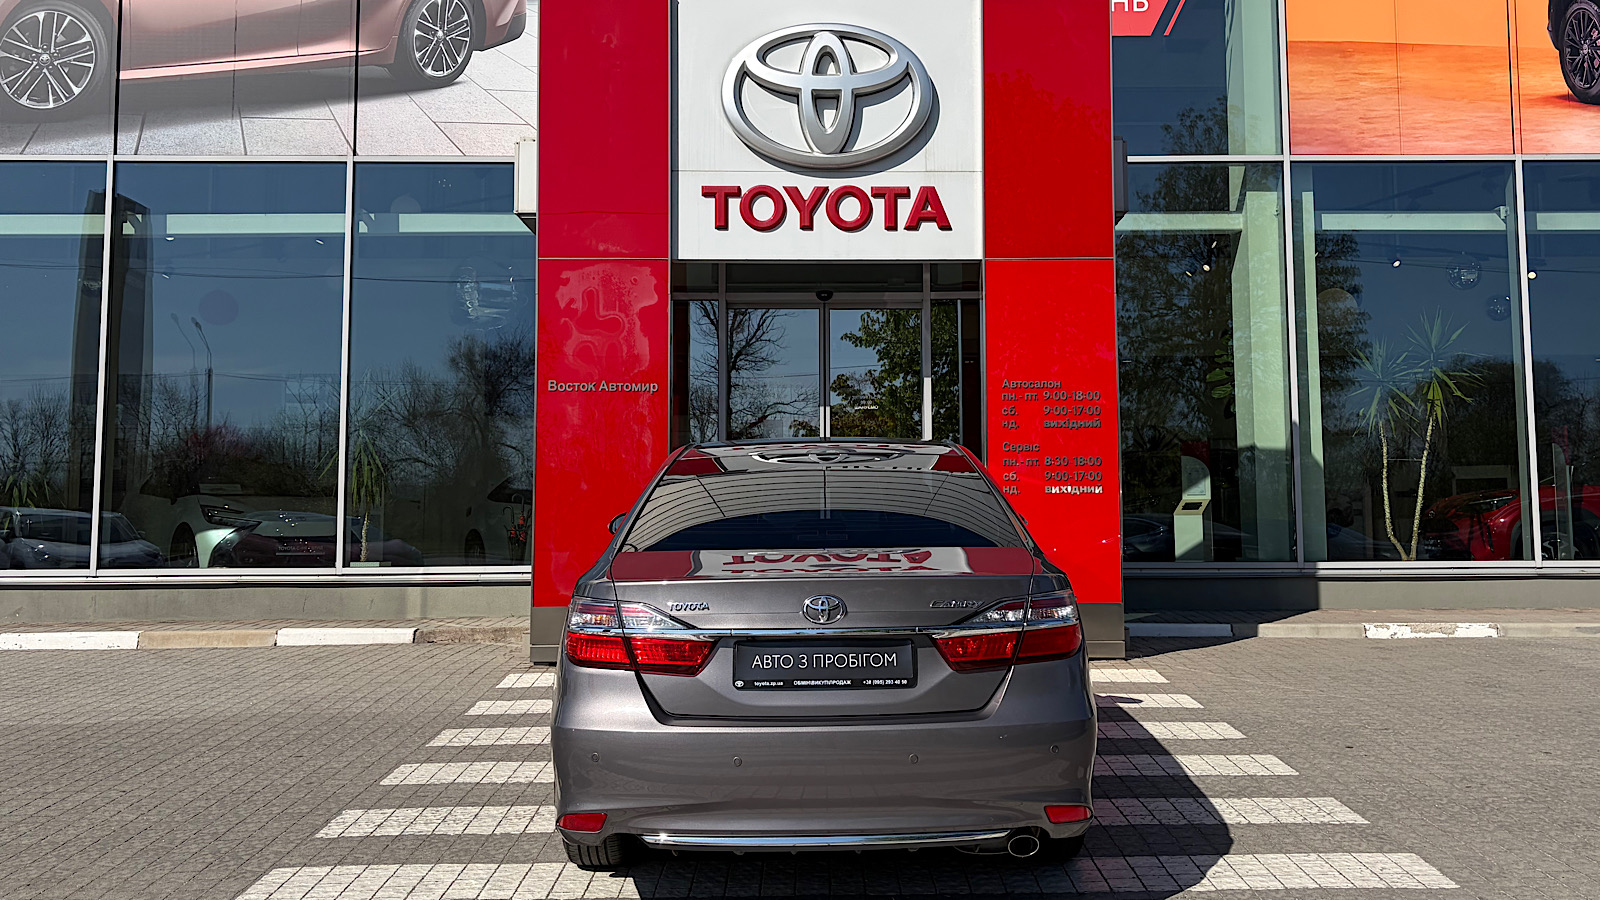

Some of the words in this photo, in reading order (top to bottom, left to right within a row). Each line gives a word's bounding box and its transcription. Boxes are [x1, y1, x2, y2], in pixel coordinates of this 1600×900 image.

[701, 185, 953, 233] TOYOTA
[548, 380, 597, 392] Восток
[599, 380, 659, 395] Автомир
[1002, 379, 1062, 389] Автосалон
[1043, 391, 1101, 401] 9:00-18:00
[1002, 406, 1019, 416] сб.
[1043, 406, 1102, 416] 9:00-17:00
[1002, 420, 1020, 430] нд.
[1044, 418, 1102, 430] вихідний
[1002, 442, 1040, 454] Сервіс
[1044, 457, 1103, 467] 8:30-18:00
[1003, 472, 1020, 482] сб.
[1044, 471, 1103, 482] 9:00-17:00
[1003, 485, 1021, 495] нд.
[1045, 484, 1104, 495] вихідний
[667, 601, 710, 612] TOYOTA
[929, 600, 984, 609] CAMRY
[751, 655, 794, 669] АВТО
[813, 653, 897, 668] ПРОБІГОМ
